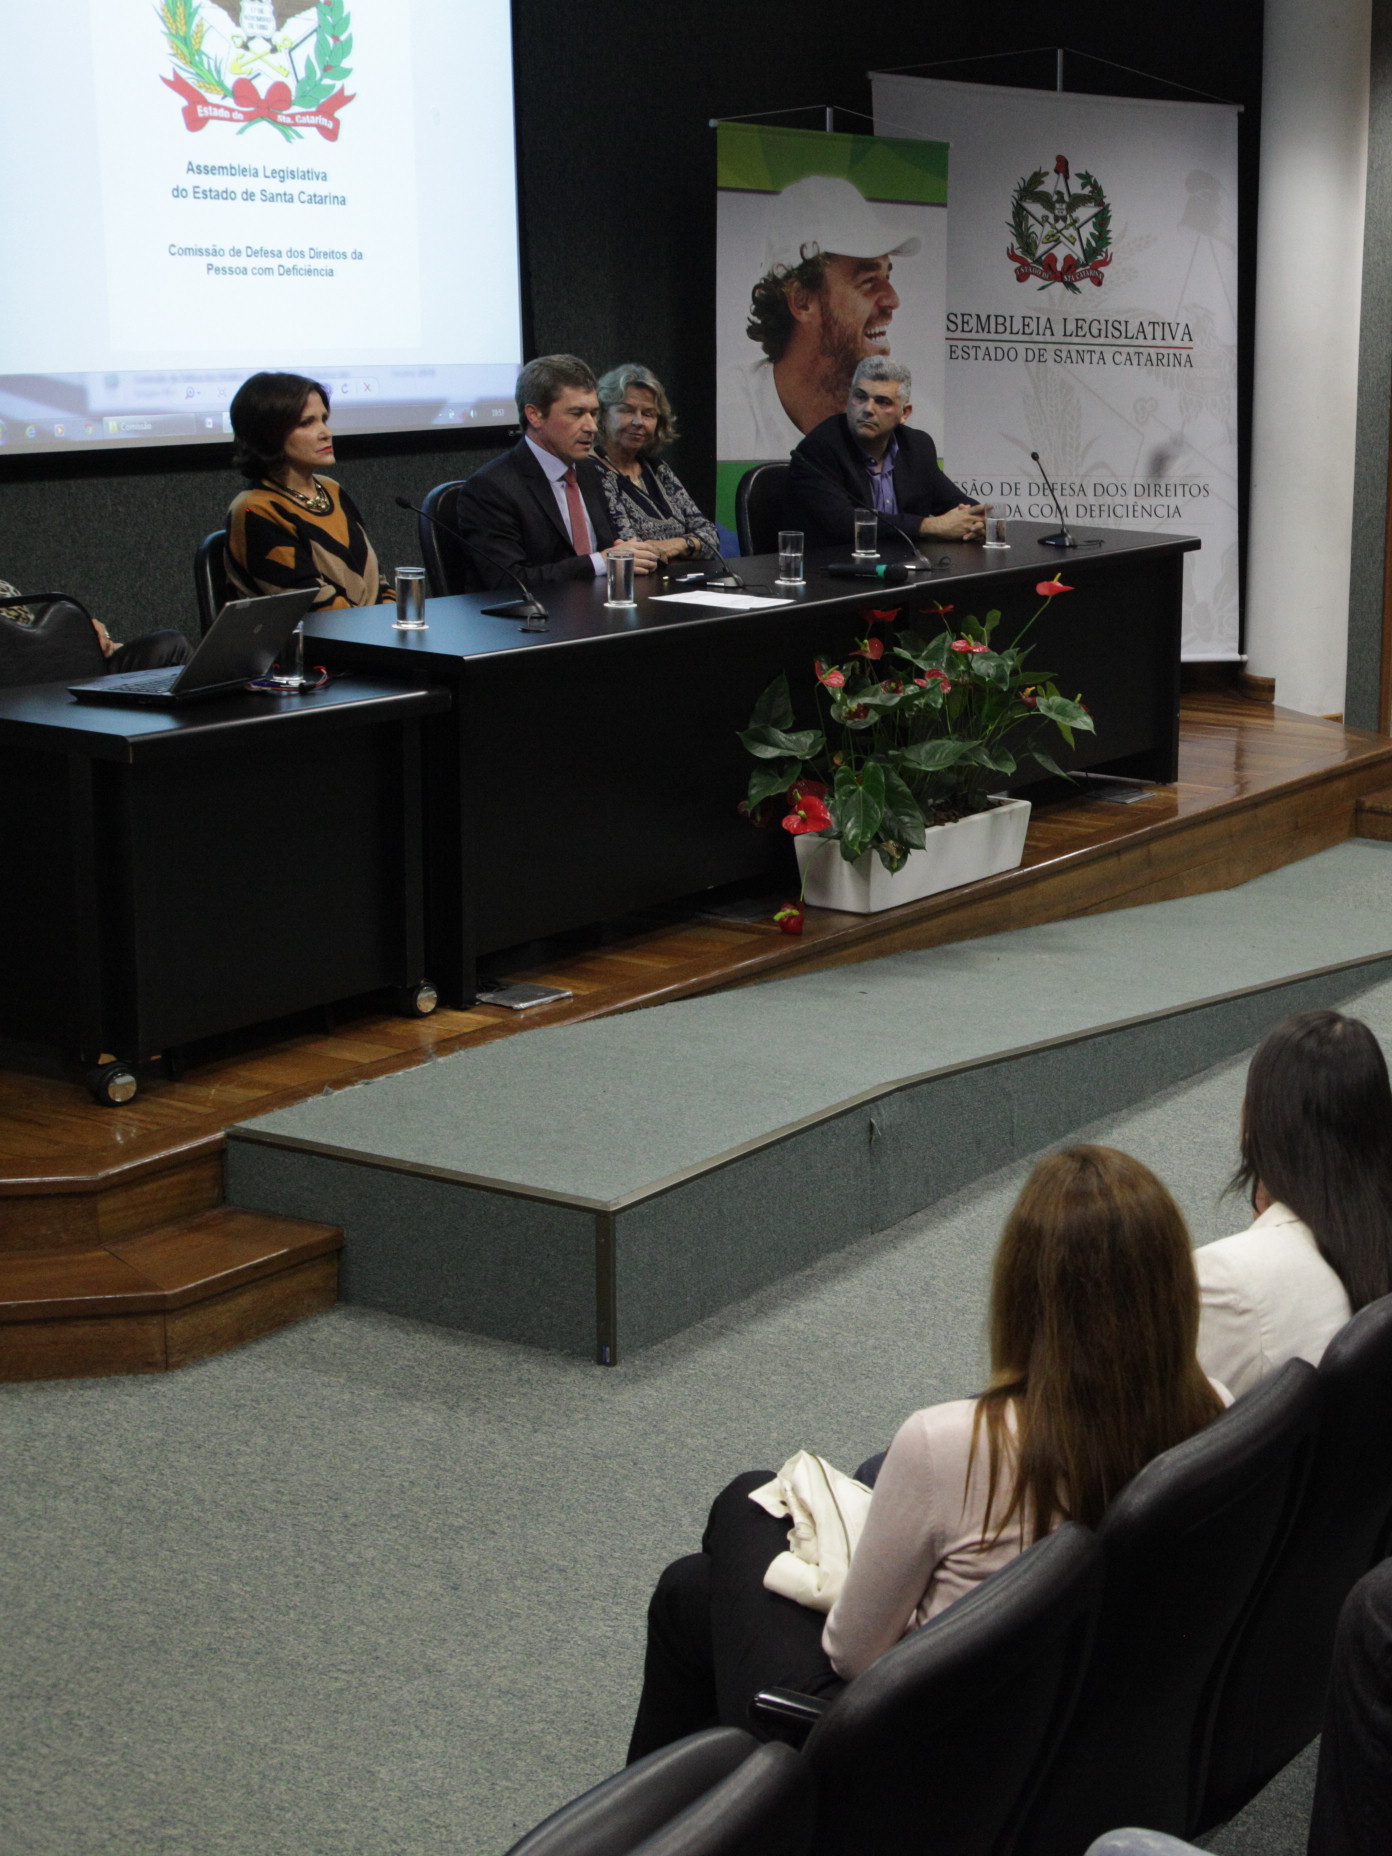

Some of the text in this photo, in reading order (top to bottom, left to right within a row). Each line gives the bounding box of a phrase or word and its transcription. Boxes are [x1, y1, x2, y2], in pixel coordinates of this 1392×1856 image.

[196, 104, 231, 119] Estado
[295, 114, 334, 130] Catarina
[186, 160, 328, 183] Assembleia Legislativa
[171, 184, 347, 206] do Estado de Santa Catarina
[168, 243, 364, 261] Comissão de Defesa dos Direitos da
[206, 262, 335, 278] Pessoa com Deficiência
[945, 312, 1194, 342] SEMBLEIA LEGISLATIVA
[948, 344, 1194, 369] ESTADO DE SANTA CATARINA
[1000, 481, 1022, 497] DE
[1028, 481, 1087, 498] DEFESA
[1093, 482, 1128, 498] DOS
[1133, 482, 1210, 499] DIREITOS
[1028, 503, 1069, 519] COM
[1076, 500, 1183, 520] DEFICIÊNCIA
